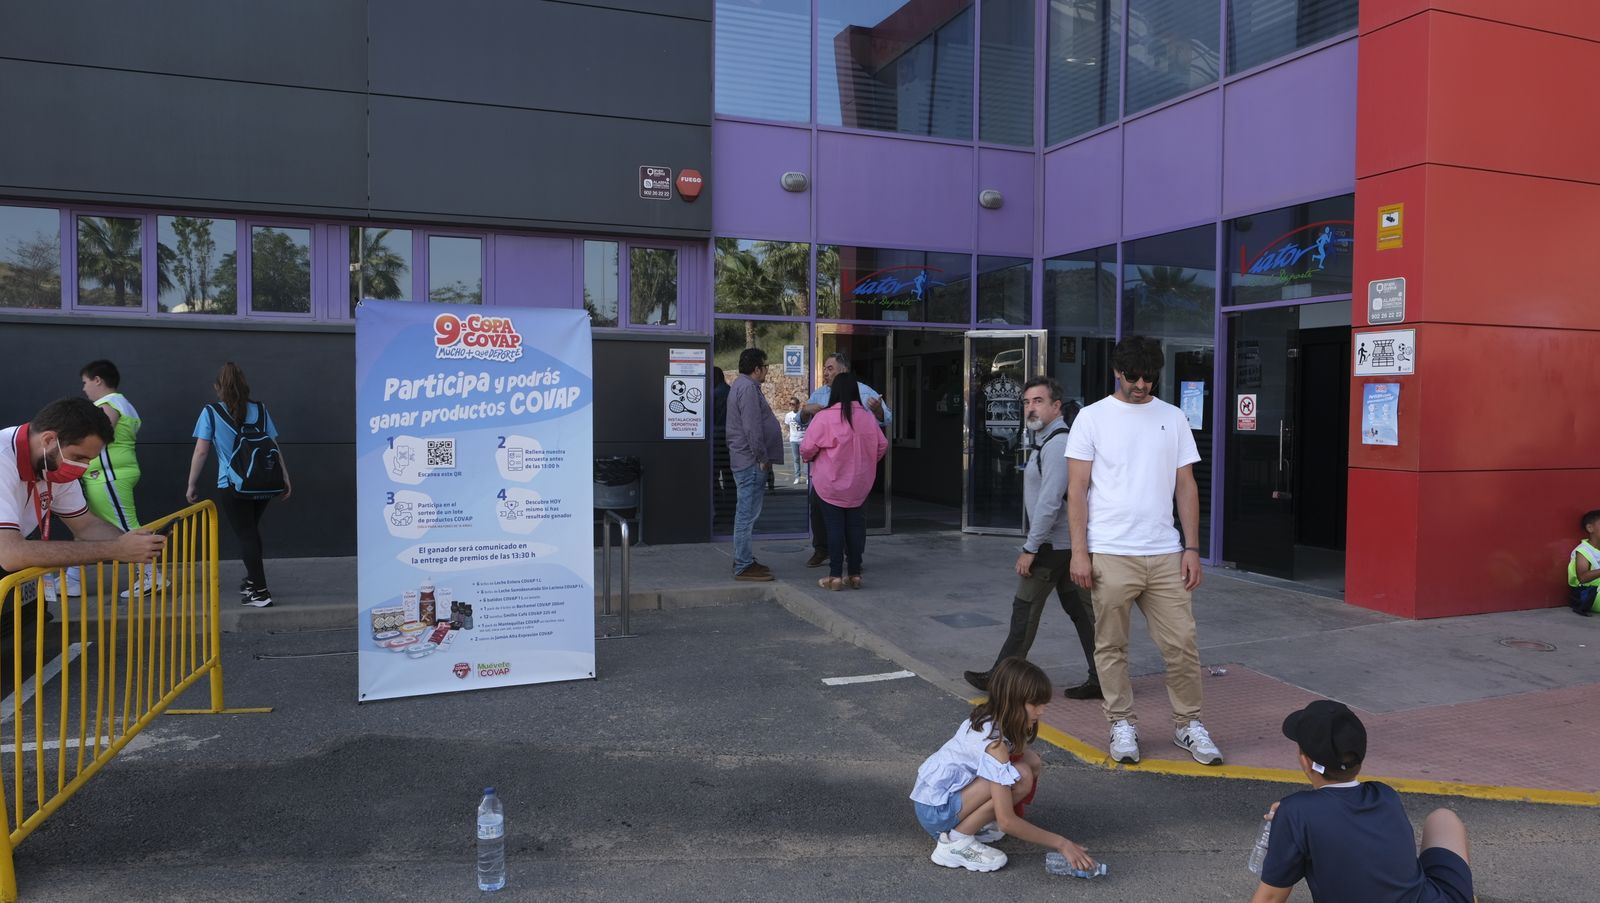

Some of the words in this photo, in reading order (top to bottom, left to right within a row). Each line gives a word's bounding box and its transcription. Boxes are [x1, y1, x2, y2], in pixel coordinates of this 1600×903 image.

[468, 316, 514, 334] COPA
[463, 332, 520, 348] COVAP
[384, 371, 491, 402] Participa
[494, 377, 504, 393] y
[507, 367, 561, 393] podrás
[369, 411, 419, 434] ganar
[420, 400, 506, 427] productos
[510, 386, 581, 415] COVAP
[387, 436, 394, 449] 1
[498, 436, 506, 449] 2
[386, 492, 395, 504] 3
[497, 488, 507, 501] 4
[475, 543, 517, 551] comunicado
[460, 554, 488, 563] premios
[480, 668, 510, 676] COVAP
[1184, 734, 1194, 747] N
